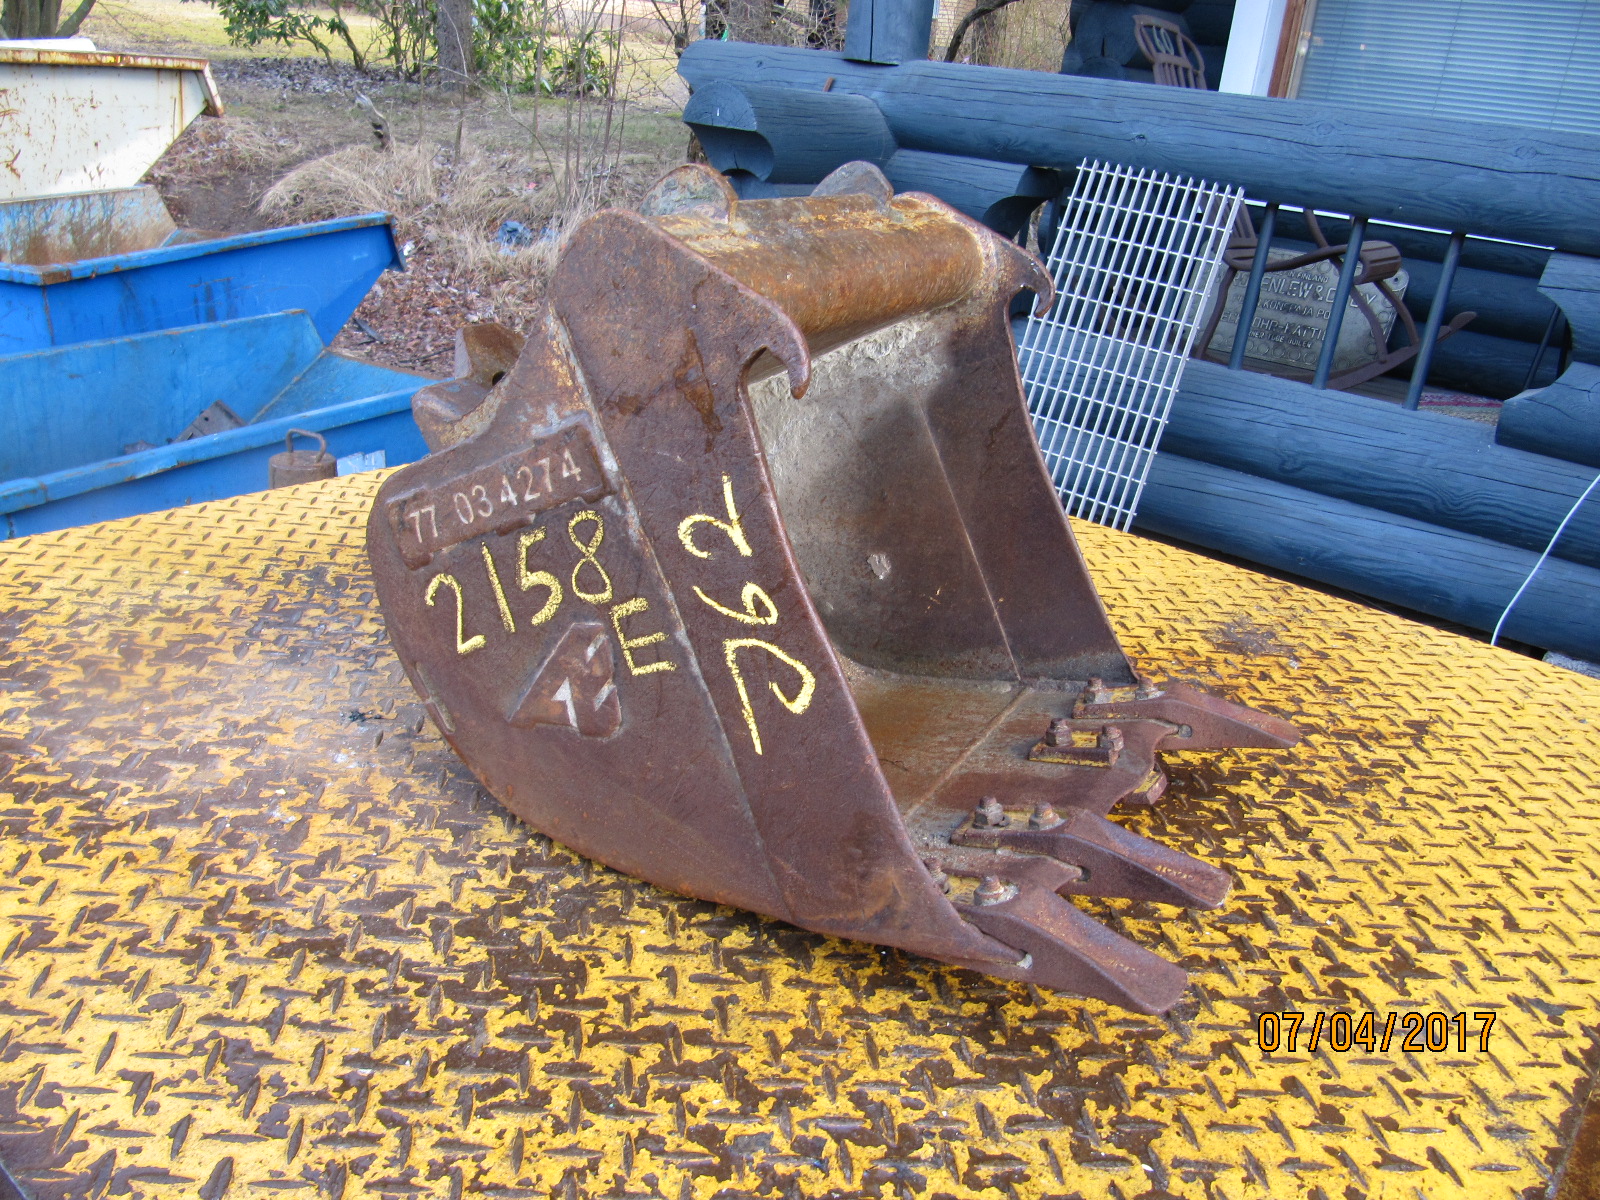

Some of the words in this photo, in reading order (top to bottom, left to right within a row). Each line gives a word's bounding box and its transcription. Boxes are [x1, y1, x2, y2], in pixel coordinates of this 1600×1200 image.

[1297, 271, 1329, 284] FINLAND
[1315, 285, 1324, 301] &
[408, 504, 438, 544] 77
[425, 510, 613, 655] 2158
[609, 597, 676, 676] E
